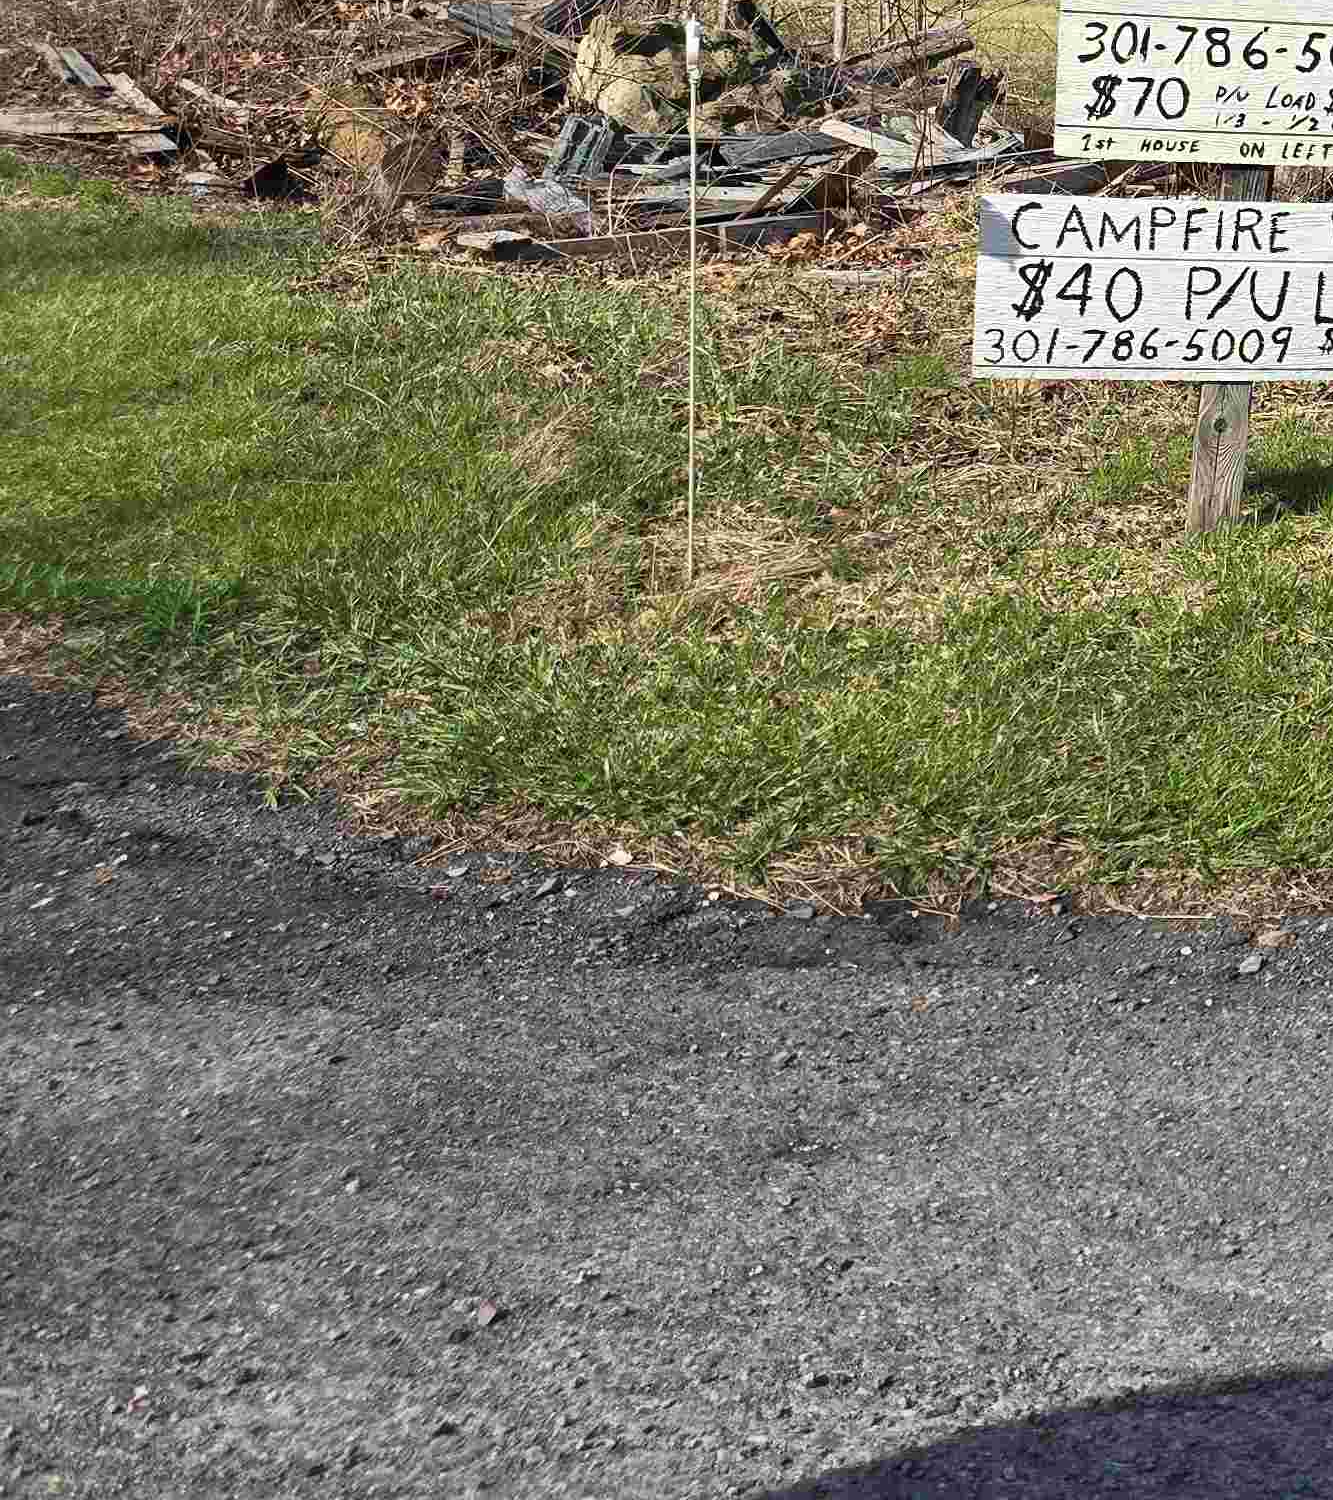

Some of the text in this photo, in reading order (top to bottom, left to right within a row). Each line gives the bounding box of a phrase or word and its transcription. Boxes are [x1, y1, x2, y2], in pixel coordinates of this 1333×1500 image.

[1084, 73, 1190, 121] $70
[1140, 138, 1201, 154] HOUSE
[1239, 141, 1265, 160] ON
[1011, 202, 1293, 253] CAMPFIRE
[1011, 260, 1145, 323] $40
[1184, 266, 1292, 322] P/U
[983, 326, 1295, 365] 301-786-5009
